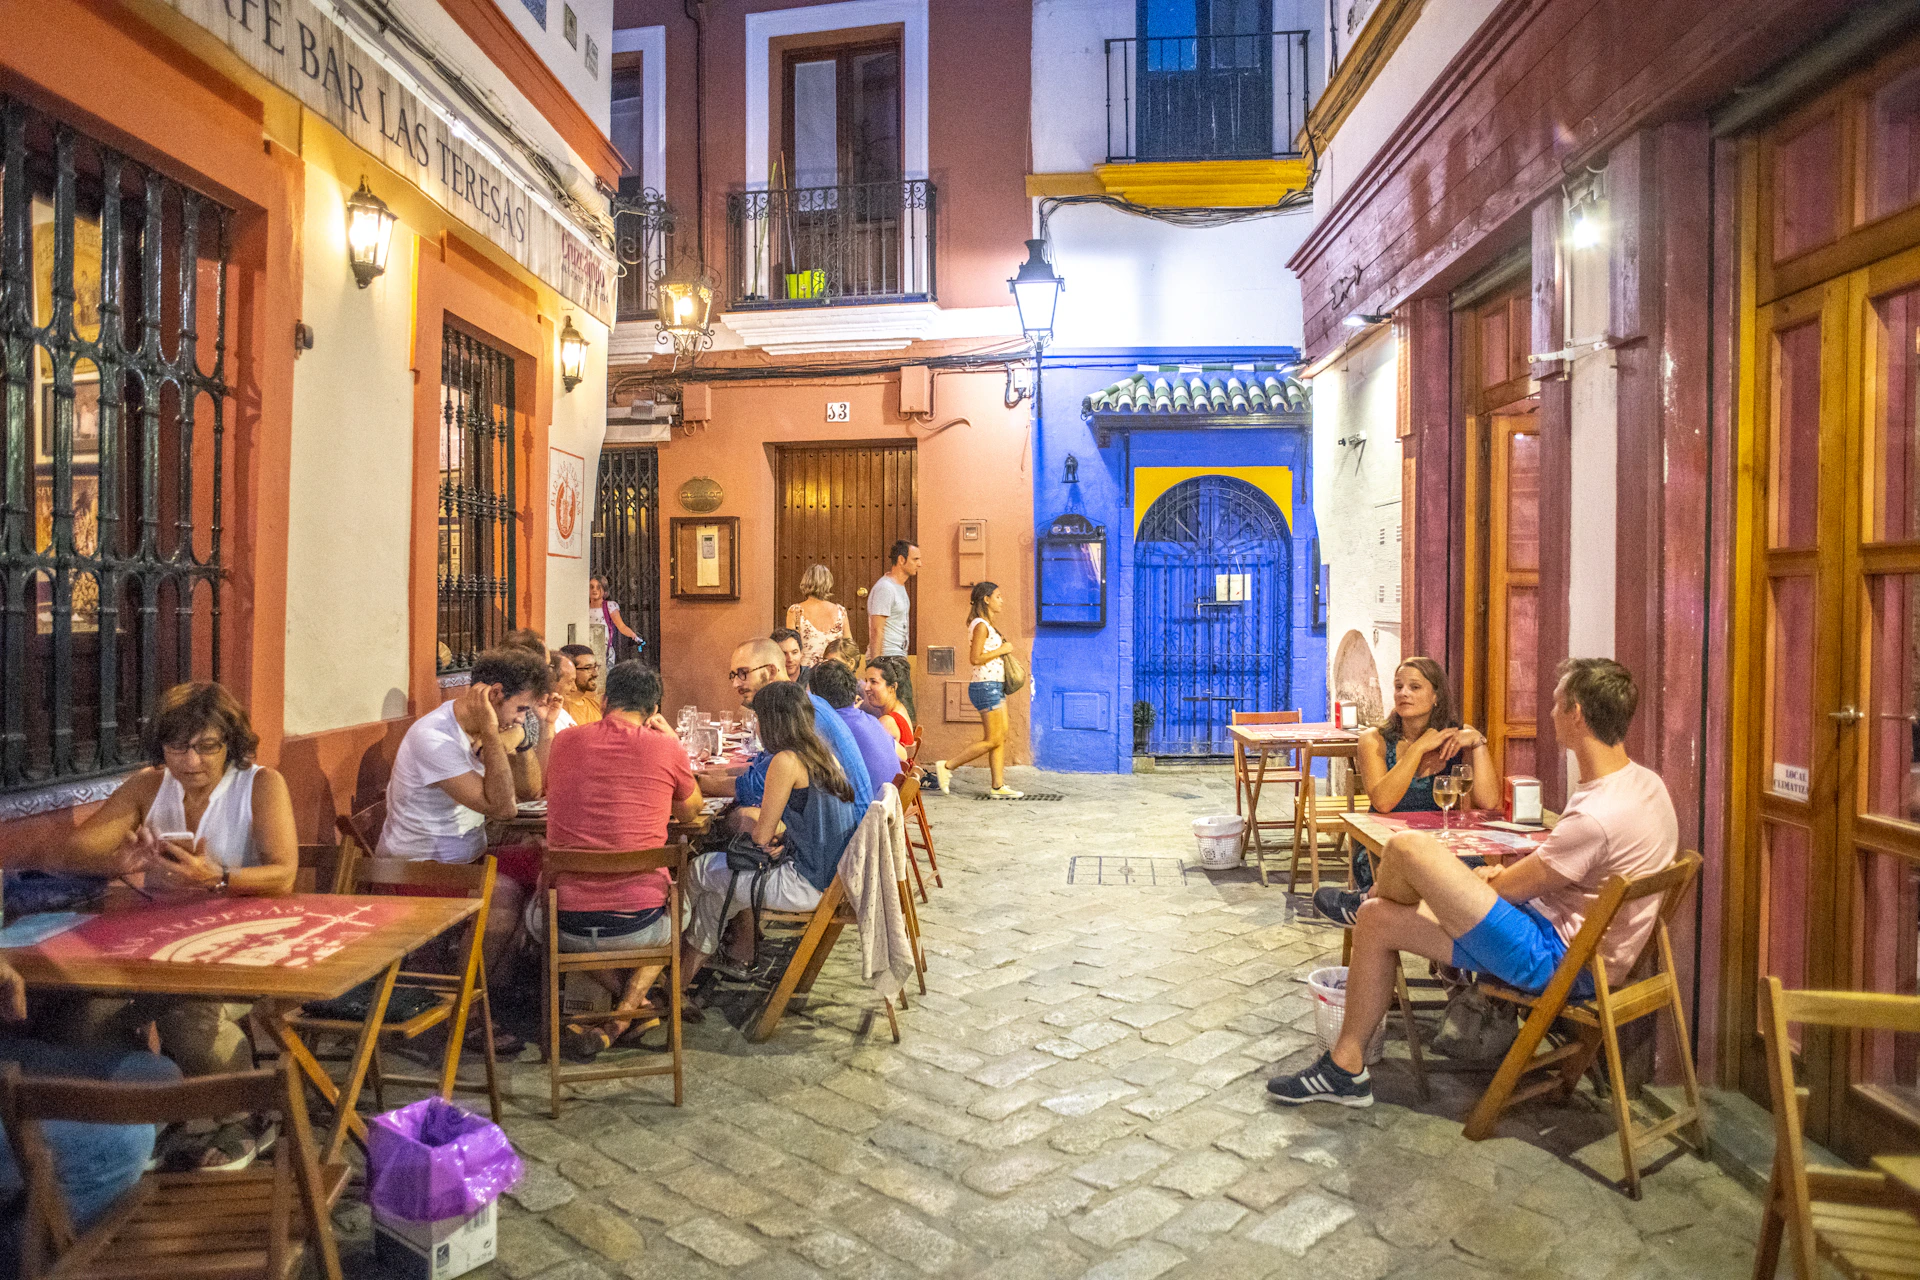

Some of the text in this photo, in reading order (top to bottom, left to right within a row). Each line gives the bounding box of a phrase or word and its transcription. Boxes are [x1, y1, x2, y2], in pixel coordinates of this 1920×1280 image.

[296, 18, 370, 124] BAR
[377, 87, 429, 168] LAS
[436, 137, 525, 243] TERESAS
[1785, 769, 1807, 782] LOCAL
